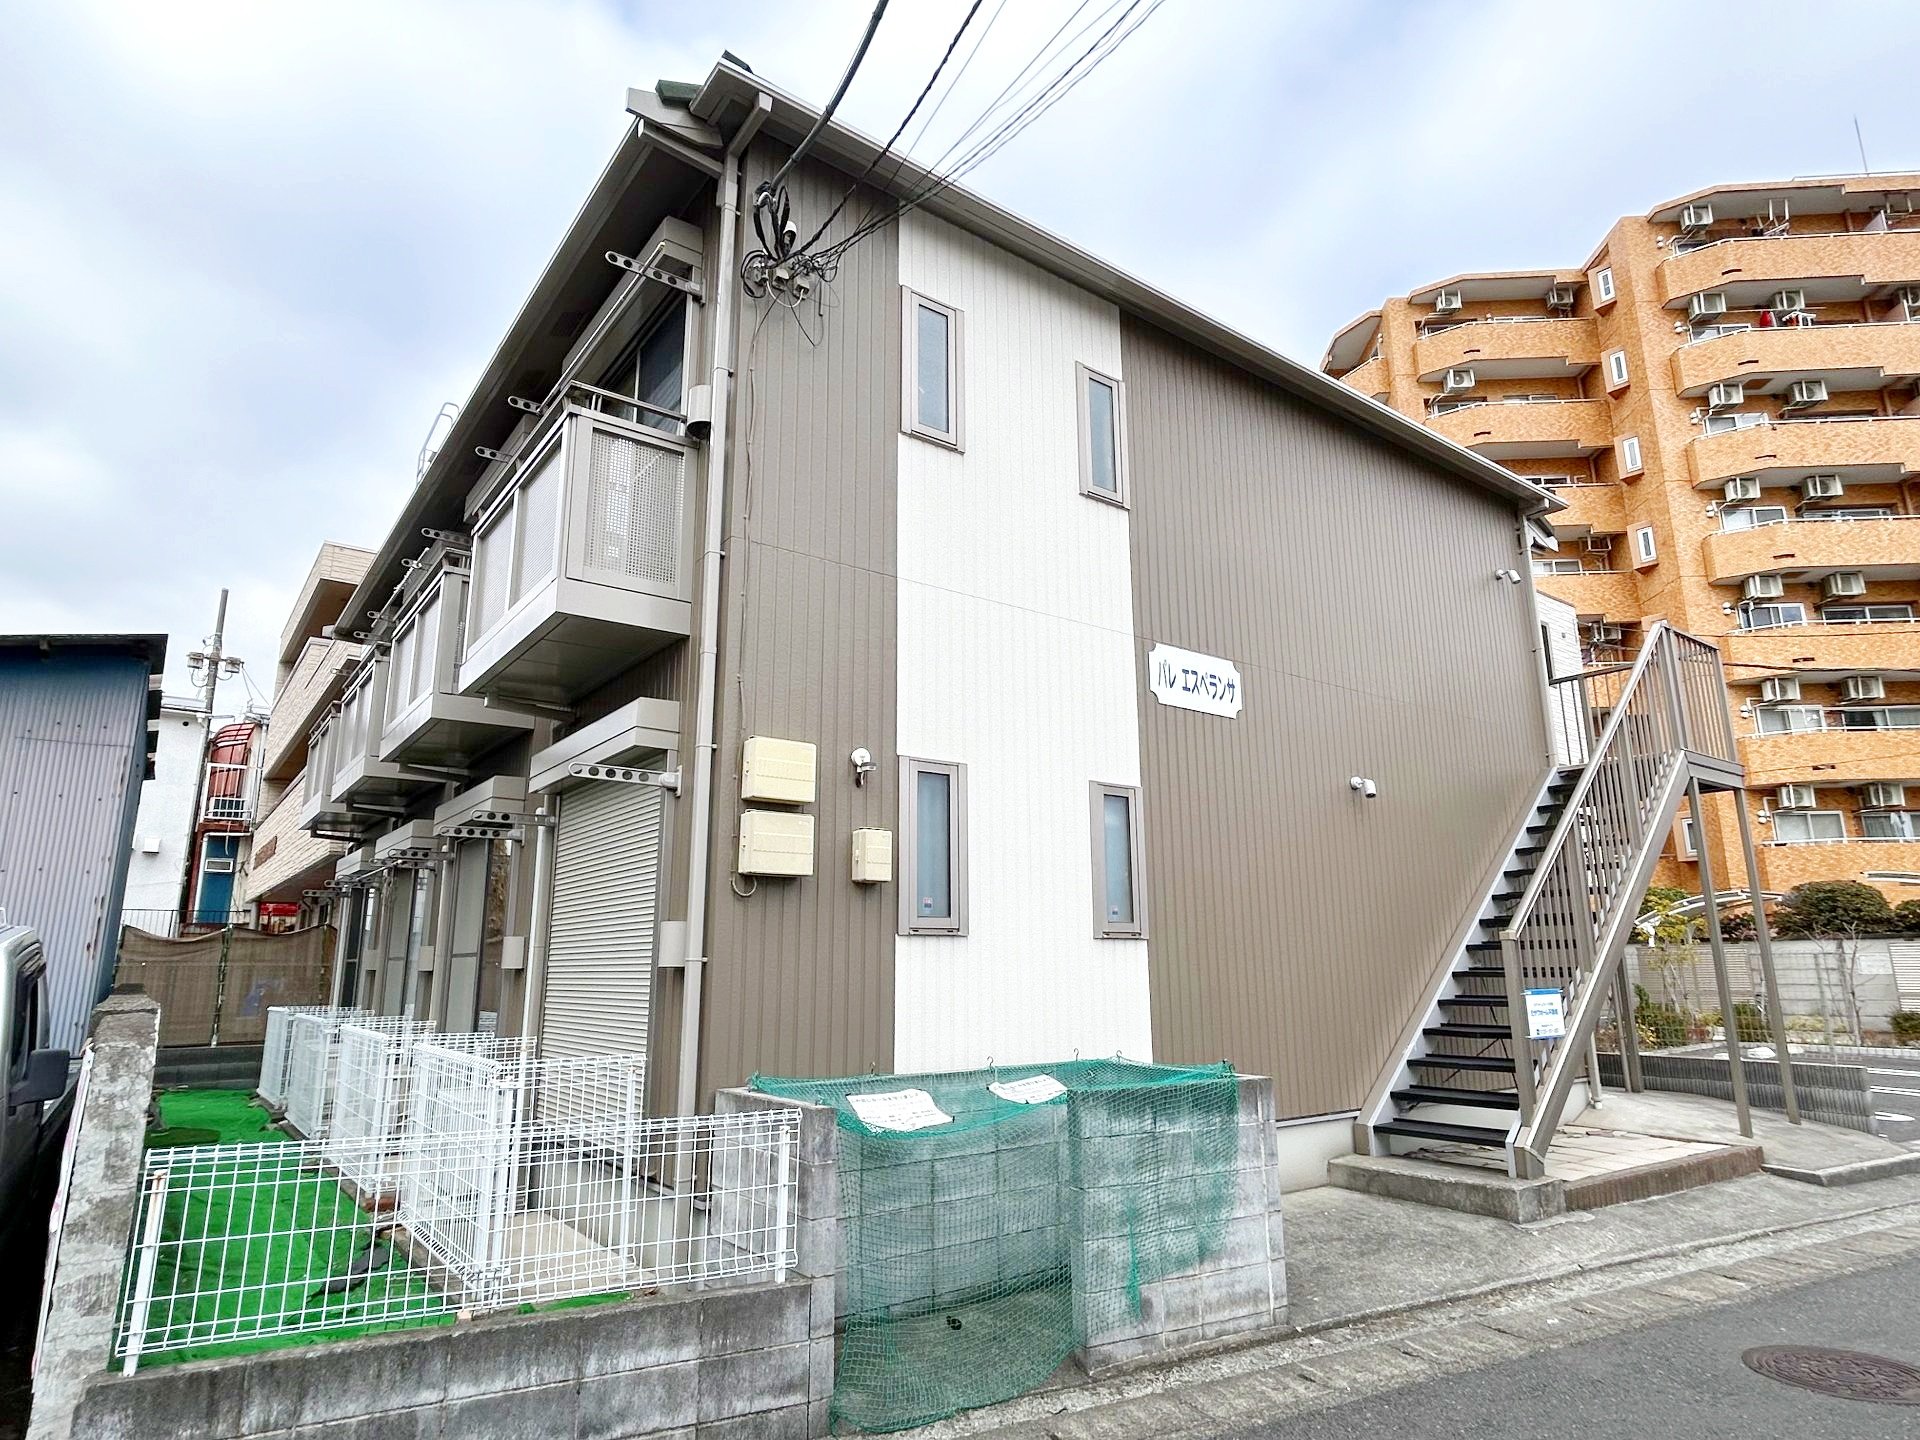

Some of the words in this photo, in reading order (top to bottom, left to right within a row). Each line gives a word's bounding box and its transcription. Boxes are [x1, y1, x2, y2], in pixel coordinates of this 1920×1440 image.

[1158, 659, 1177, 689] パレ
[1181, 668, 1236, 704] エスペランサ
